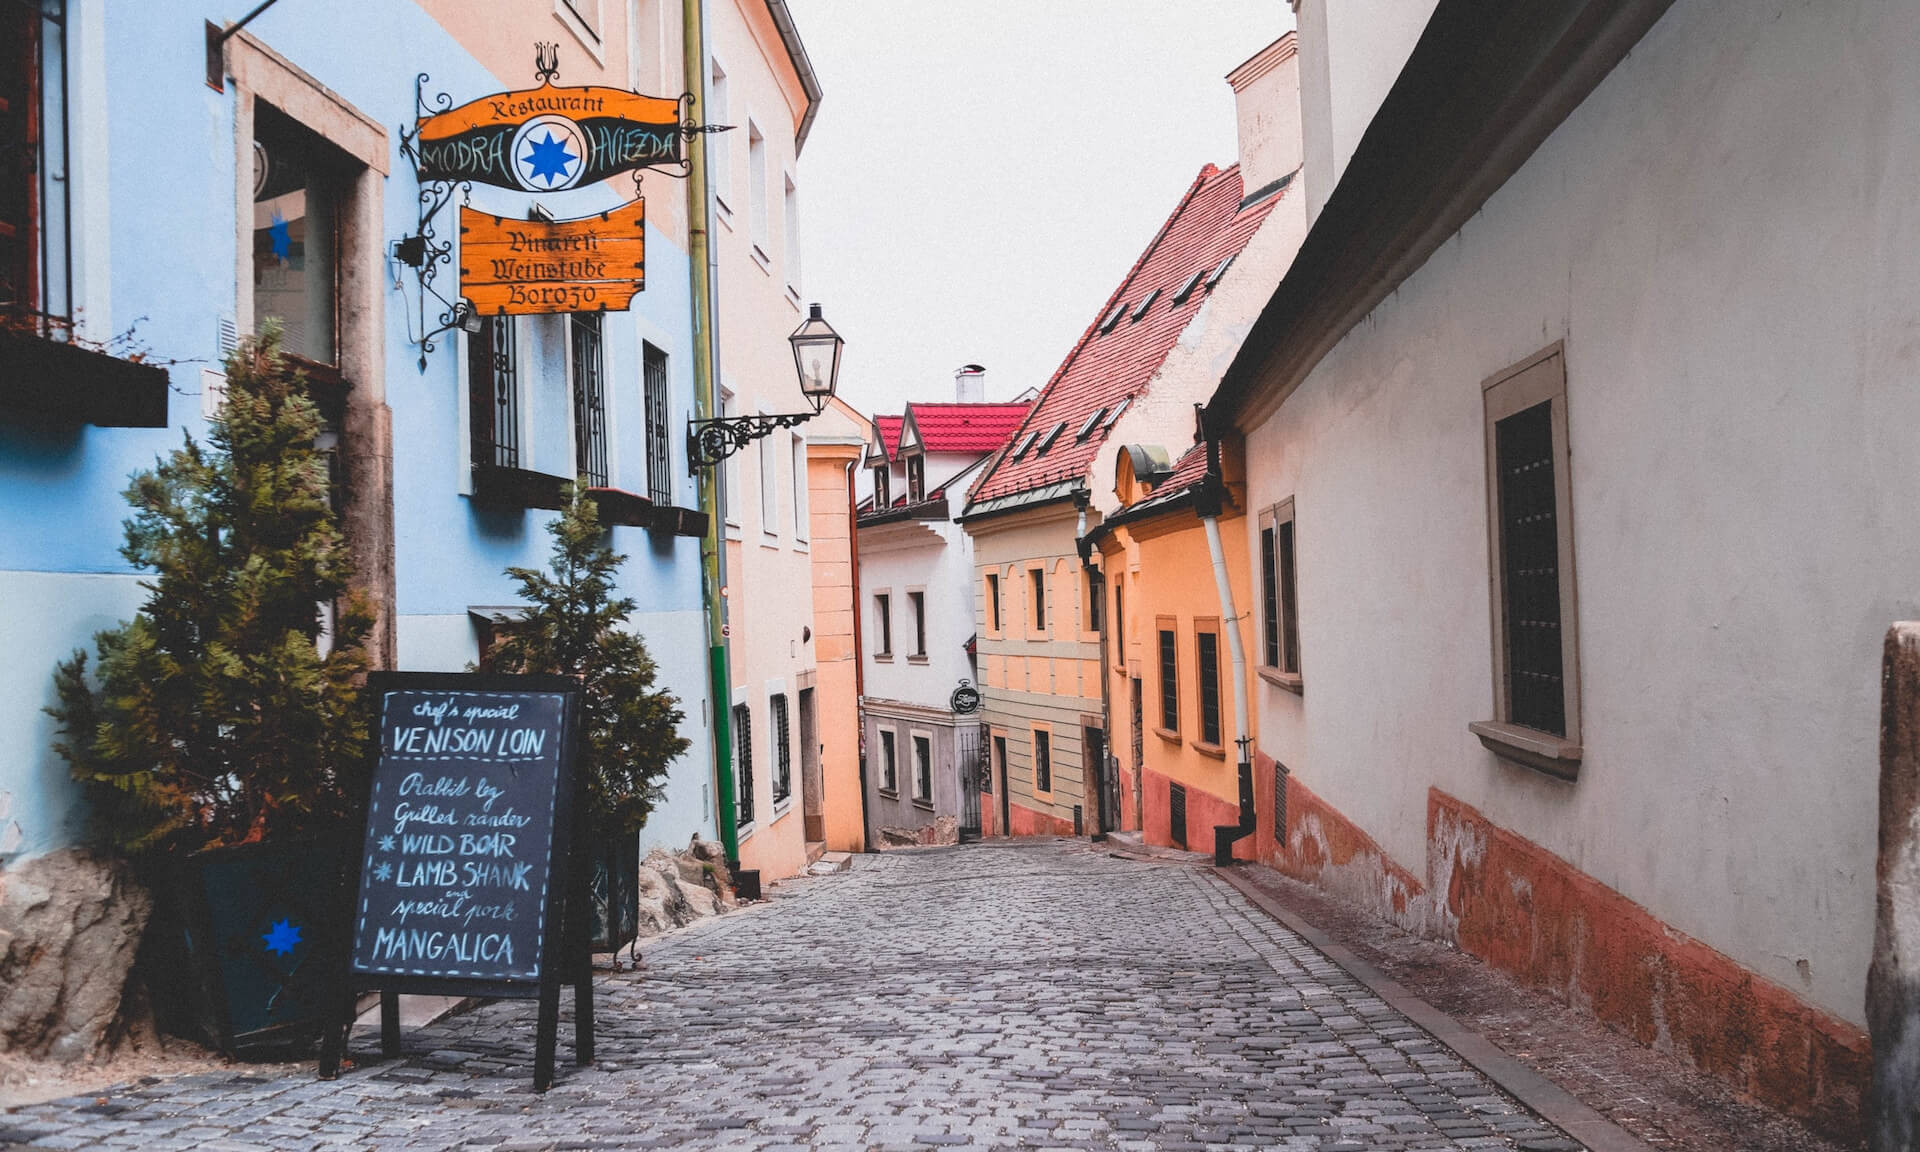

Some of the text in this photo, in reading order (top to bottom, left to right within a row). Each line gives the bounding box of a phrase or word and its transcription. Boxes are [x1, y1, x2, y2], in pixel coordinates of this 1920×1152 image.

[490, 96, 603, 120] Restaurant
[490, 258, 606, 279] Weinstube
[509, 285, 596, 309] Borozo
[413, 697, 519, 726] chef's special
[393, 726, 546, 756] VENISON LOIN
[399, 772, 505, 812] Rabbit leg
[394, 802, 459, 835] Grilled
[401, 832, 516, 858] WILD BOAR
[396, 860, 533, 892] LAMB SHANK
[390, 897, 519, 928] special pork
[371, 926, 514, 965] MANGALICA
